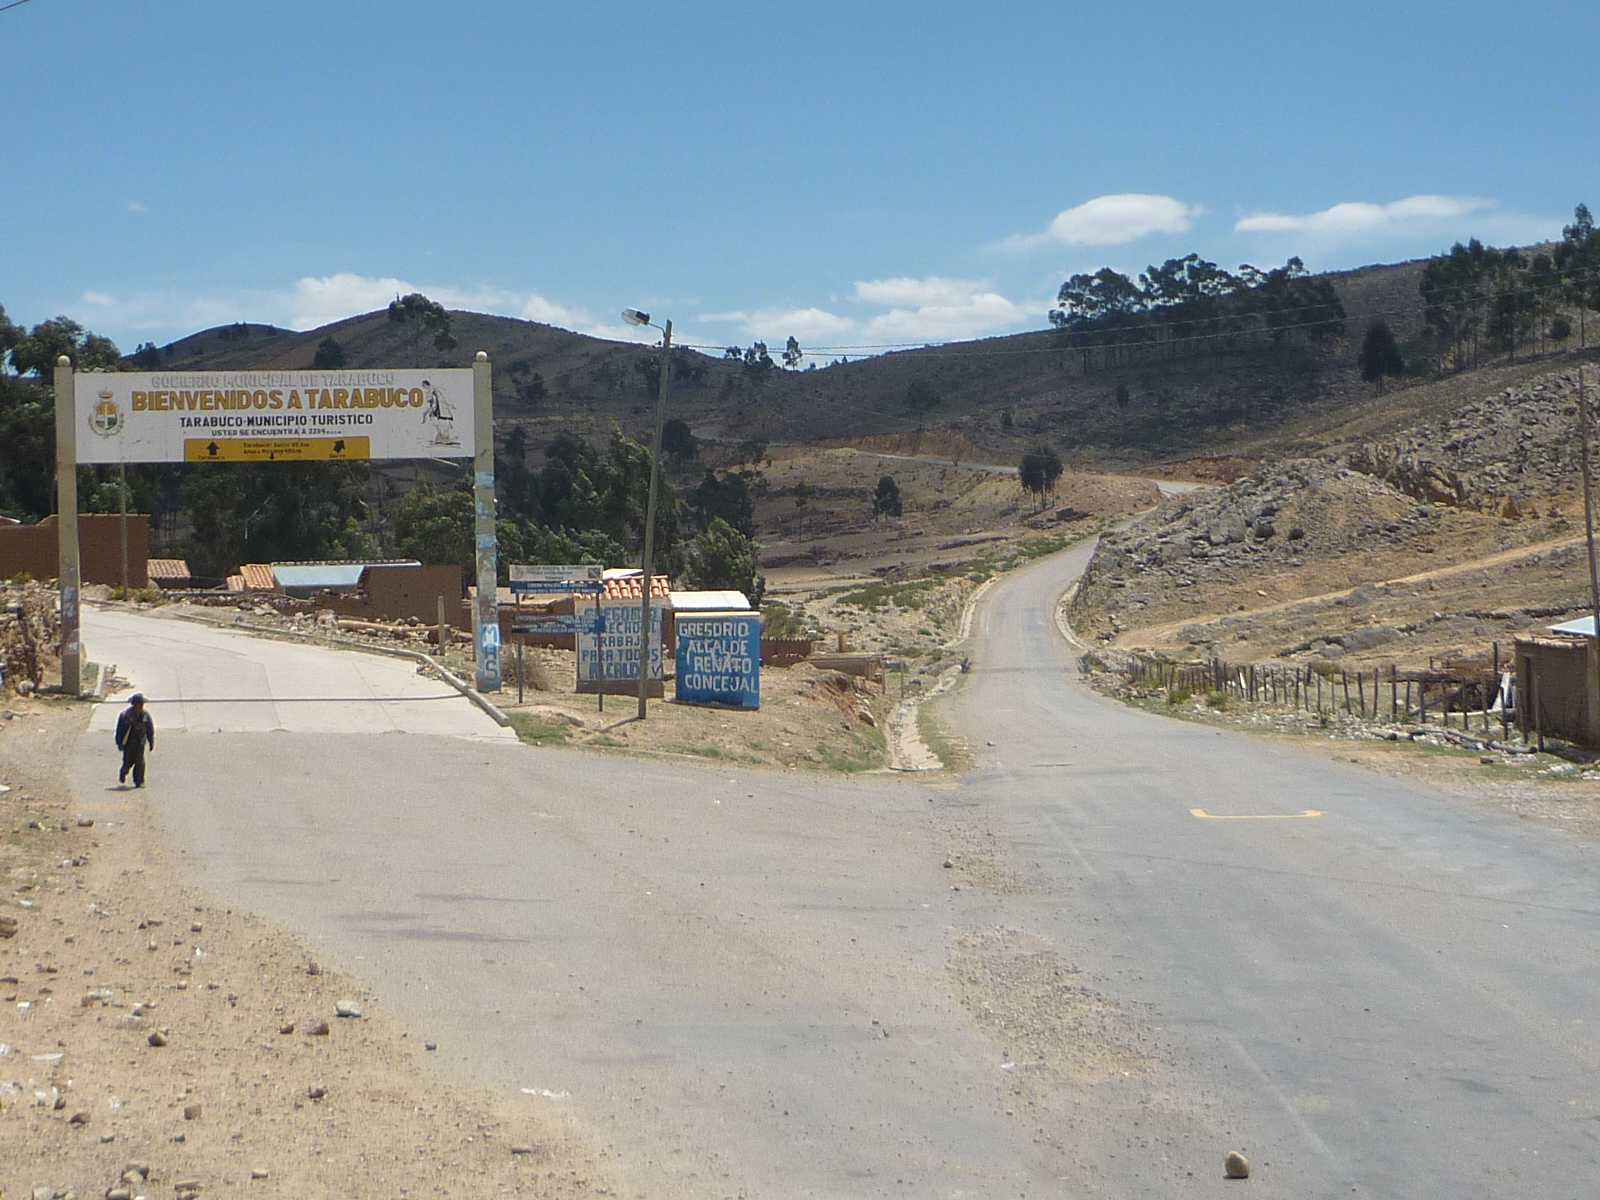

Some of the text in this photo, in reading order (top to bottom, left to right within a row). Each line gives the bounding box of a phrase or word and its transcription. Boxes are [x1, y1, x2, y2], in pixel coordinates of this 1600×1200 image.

[151, 373, 395, 388] GOBIERNO MUNICIPAL DE TARABUCO
[131, 387, 424, 411] BIENVENIDOS A TARABUCO
[311, 414, 373, 425] TURISTICO
[251, 428, 300, 436] ENCUENTRA
[679, 622, 750, 637] GREGORIO
[688, 638, 749, 656] ALCALDE
[617, 648, 659, 662] TODS
[693, 656, 752, 674] RENATO
[684, 673, 759, 694] CONCEJAL
